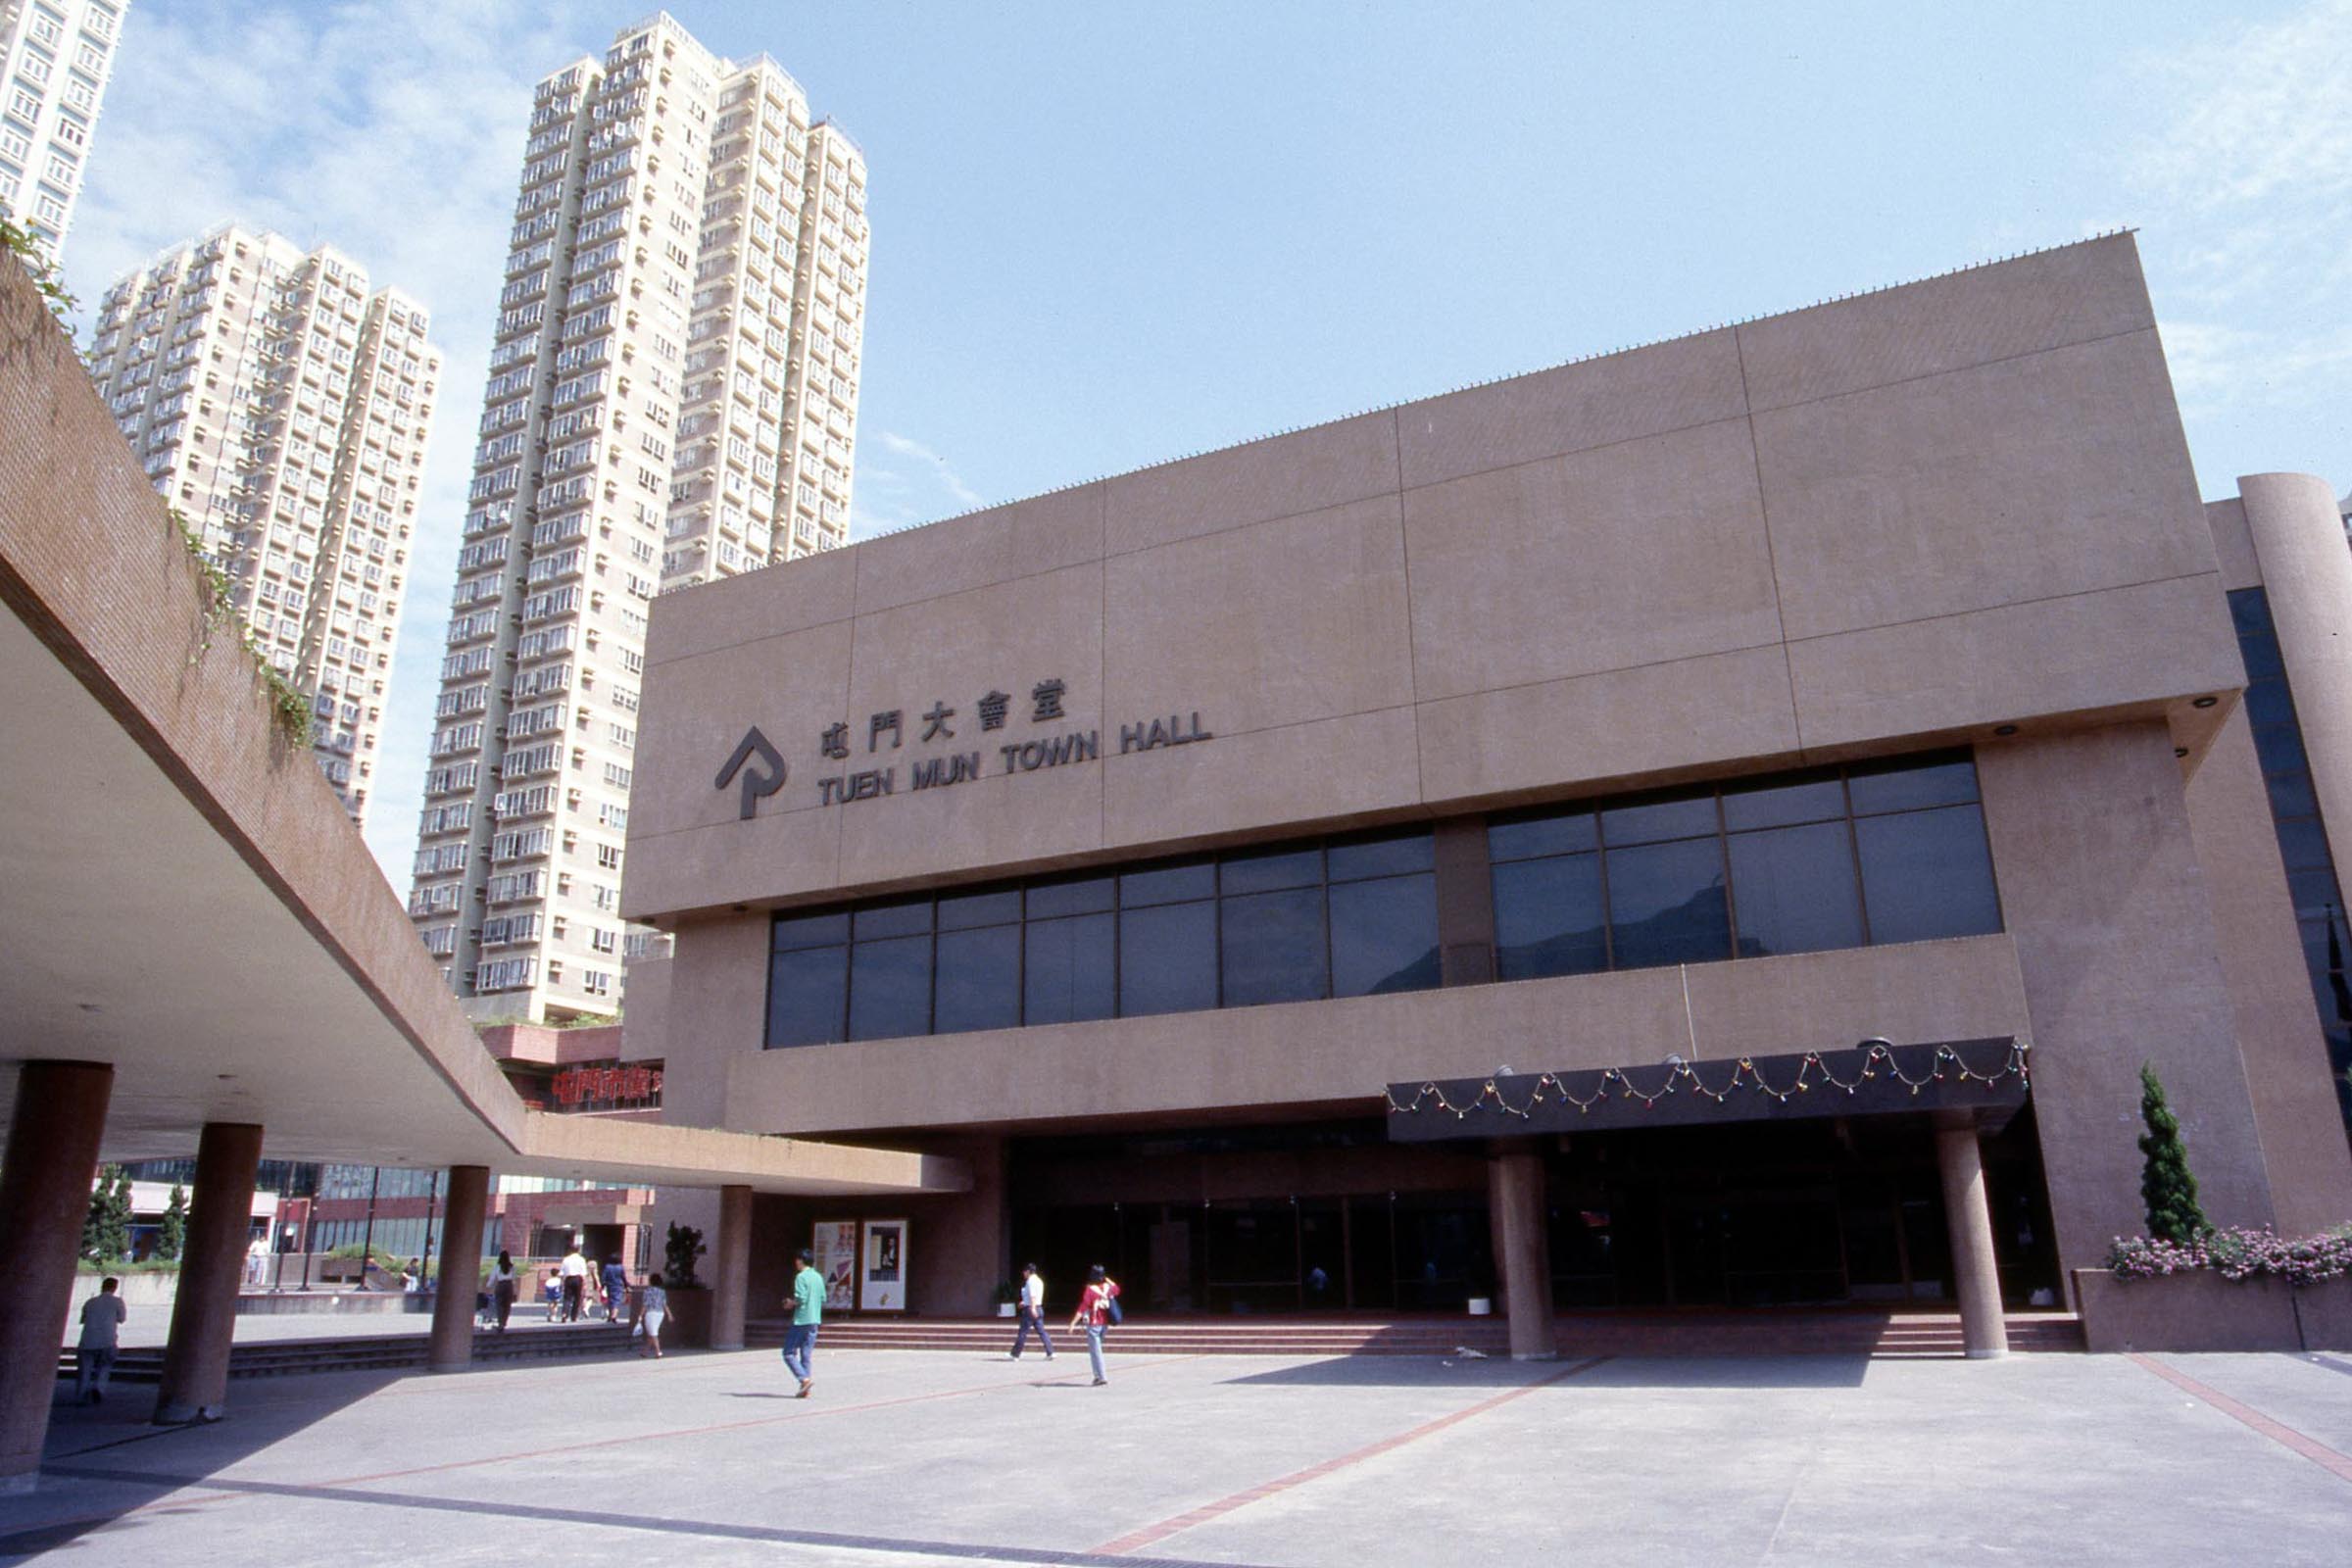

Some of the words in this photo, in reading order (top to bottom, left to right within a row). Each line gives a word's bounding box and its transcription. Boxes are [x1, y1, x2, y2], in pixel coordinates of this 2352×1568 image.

[817, 765, 895, 807] TUEN
[912, 751, 981, 791] MUN
[1001, 730, 1100, 774] TOWN
[1120, 711, 1212, 755] HALL
[820, 678, 1068, 760] 屯門大會堂
